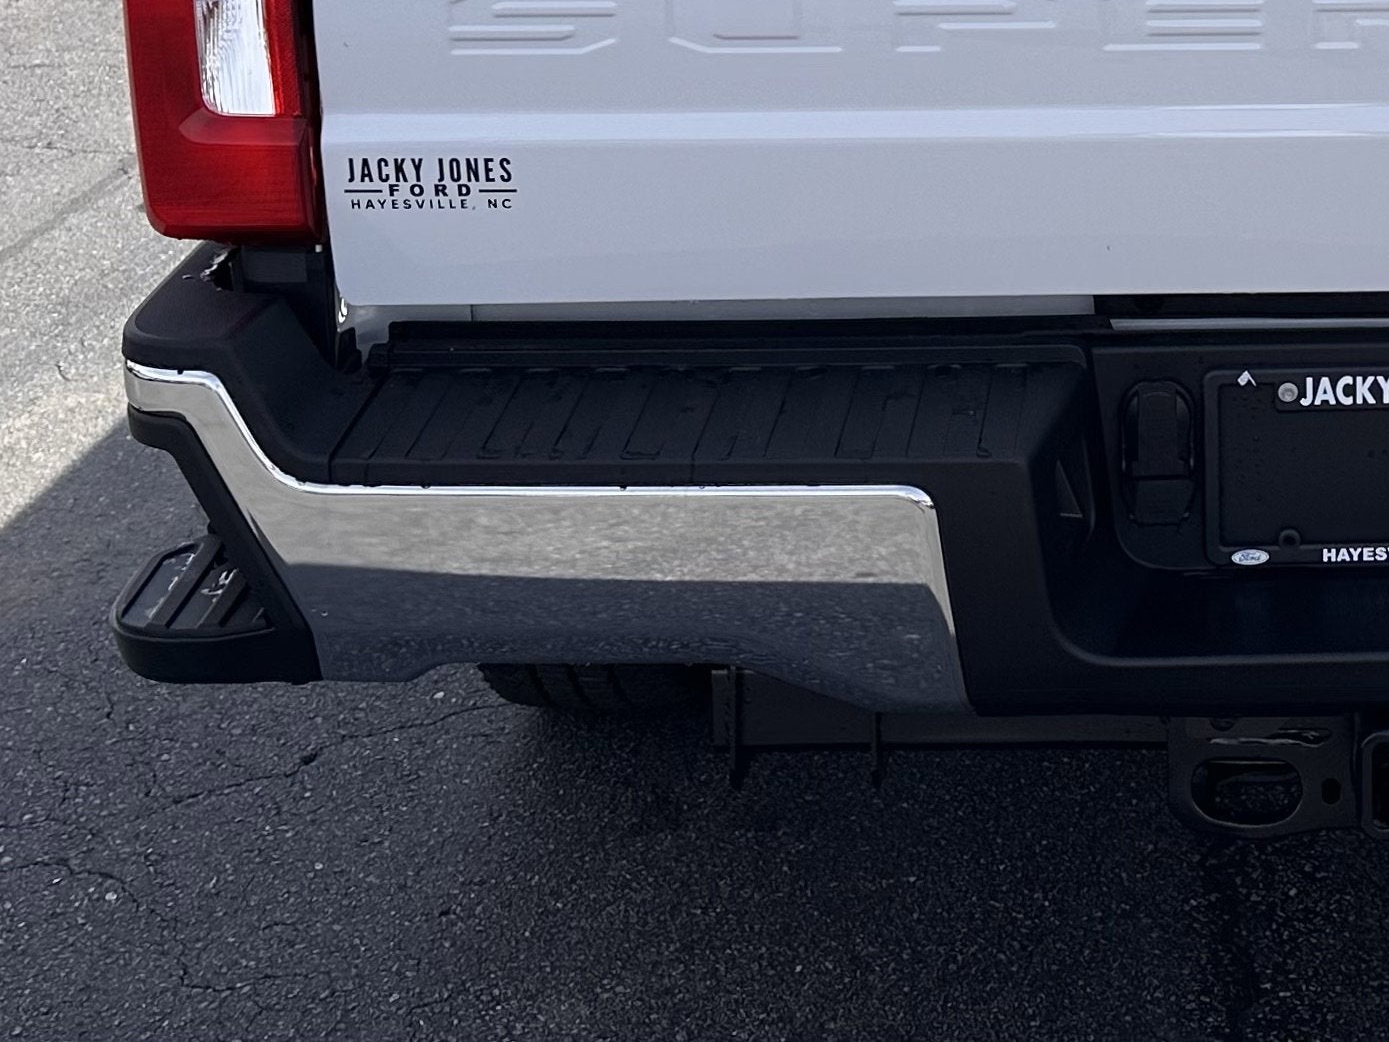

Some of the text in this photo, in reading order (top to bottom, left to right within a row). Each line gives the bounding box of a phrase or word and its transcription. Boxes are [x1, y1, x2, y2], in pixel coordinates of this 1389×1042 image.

[348, 157, 512, 183] JACKY JONES
[388, 184, 471, 197] FORD
[351, 199, 513, 210] HAYESVILLE, NC
